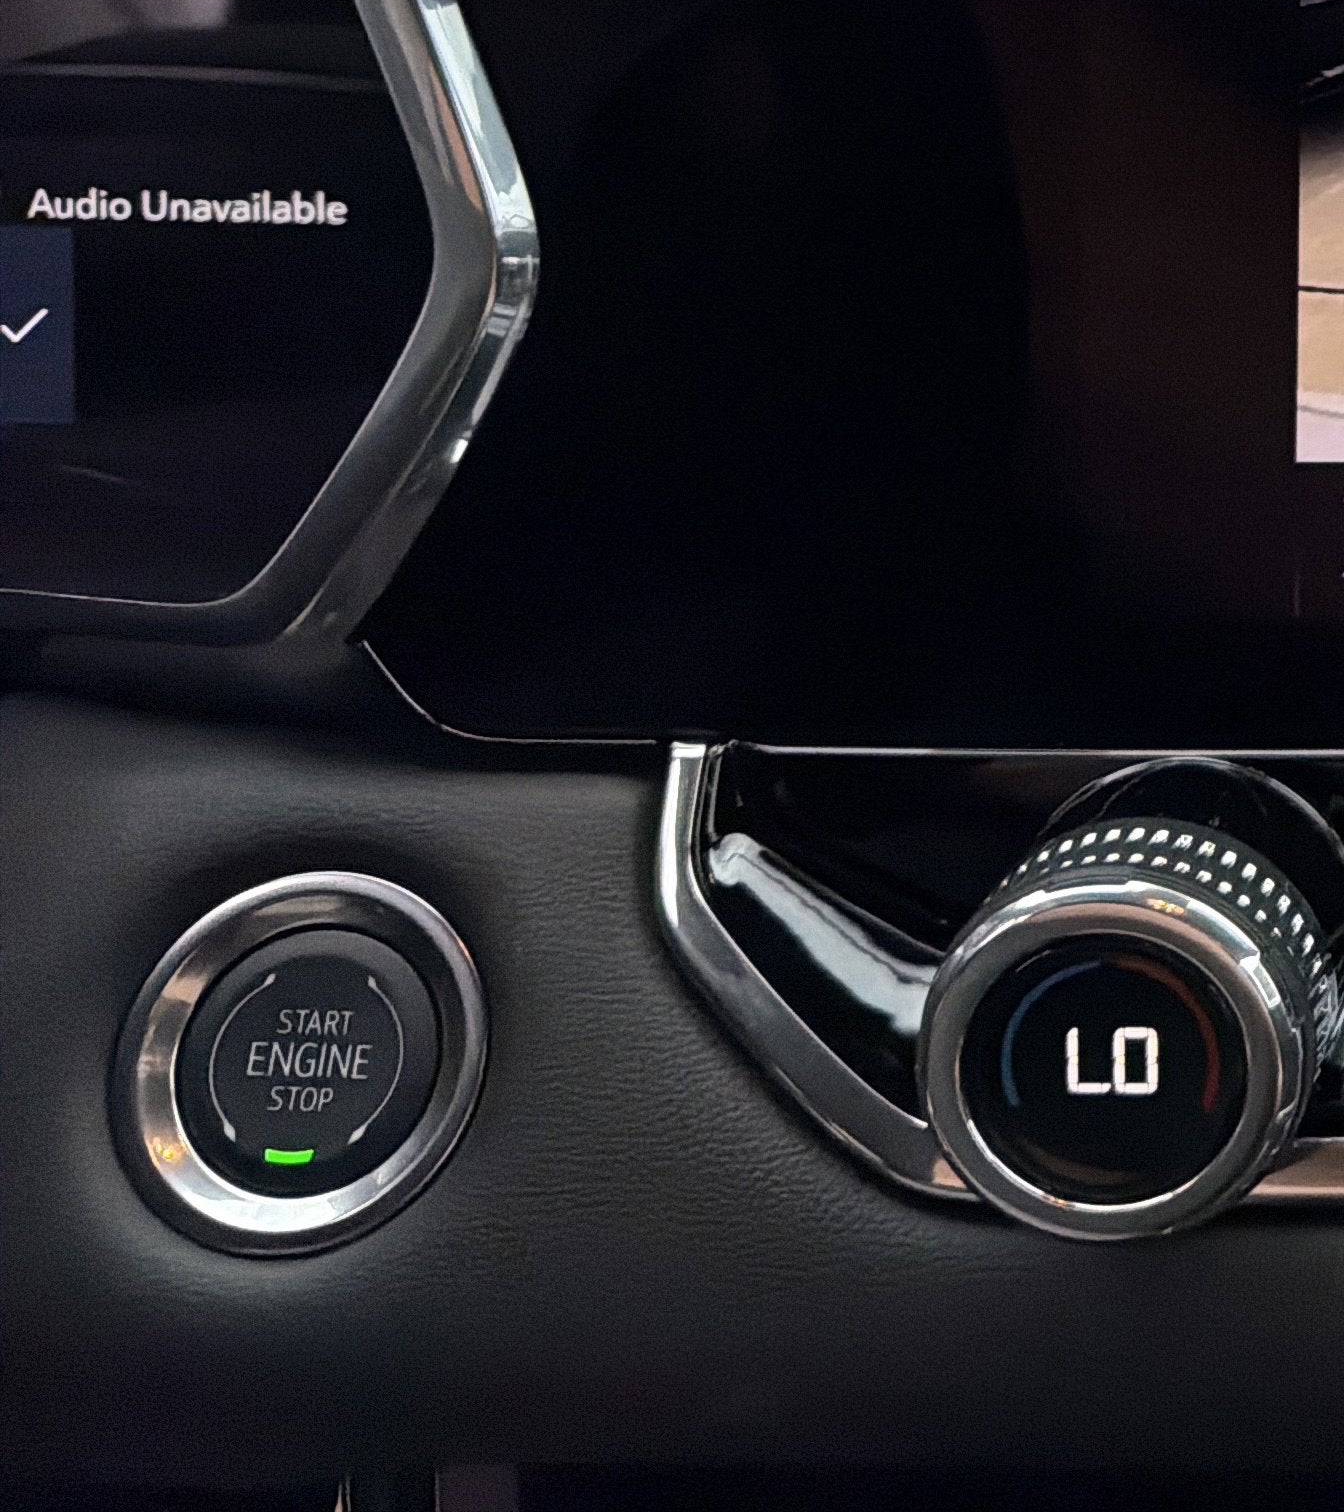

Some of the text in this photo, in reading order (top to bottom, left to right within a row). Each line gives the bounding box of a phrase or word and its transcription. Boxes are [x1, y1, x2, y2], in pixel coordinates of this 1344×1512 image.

[27, 186, 349, 226] Audio Unavailable
[276, 1008, 355, 1037] START
[246, 1040, 374, 1080] ENGINE
[1064, 1025, 1160, 1096] LO
[266, 1085, 335, 1113] STOP
